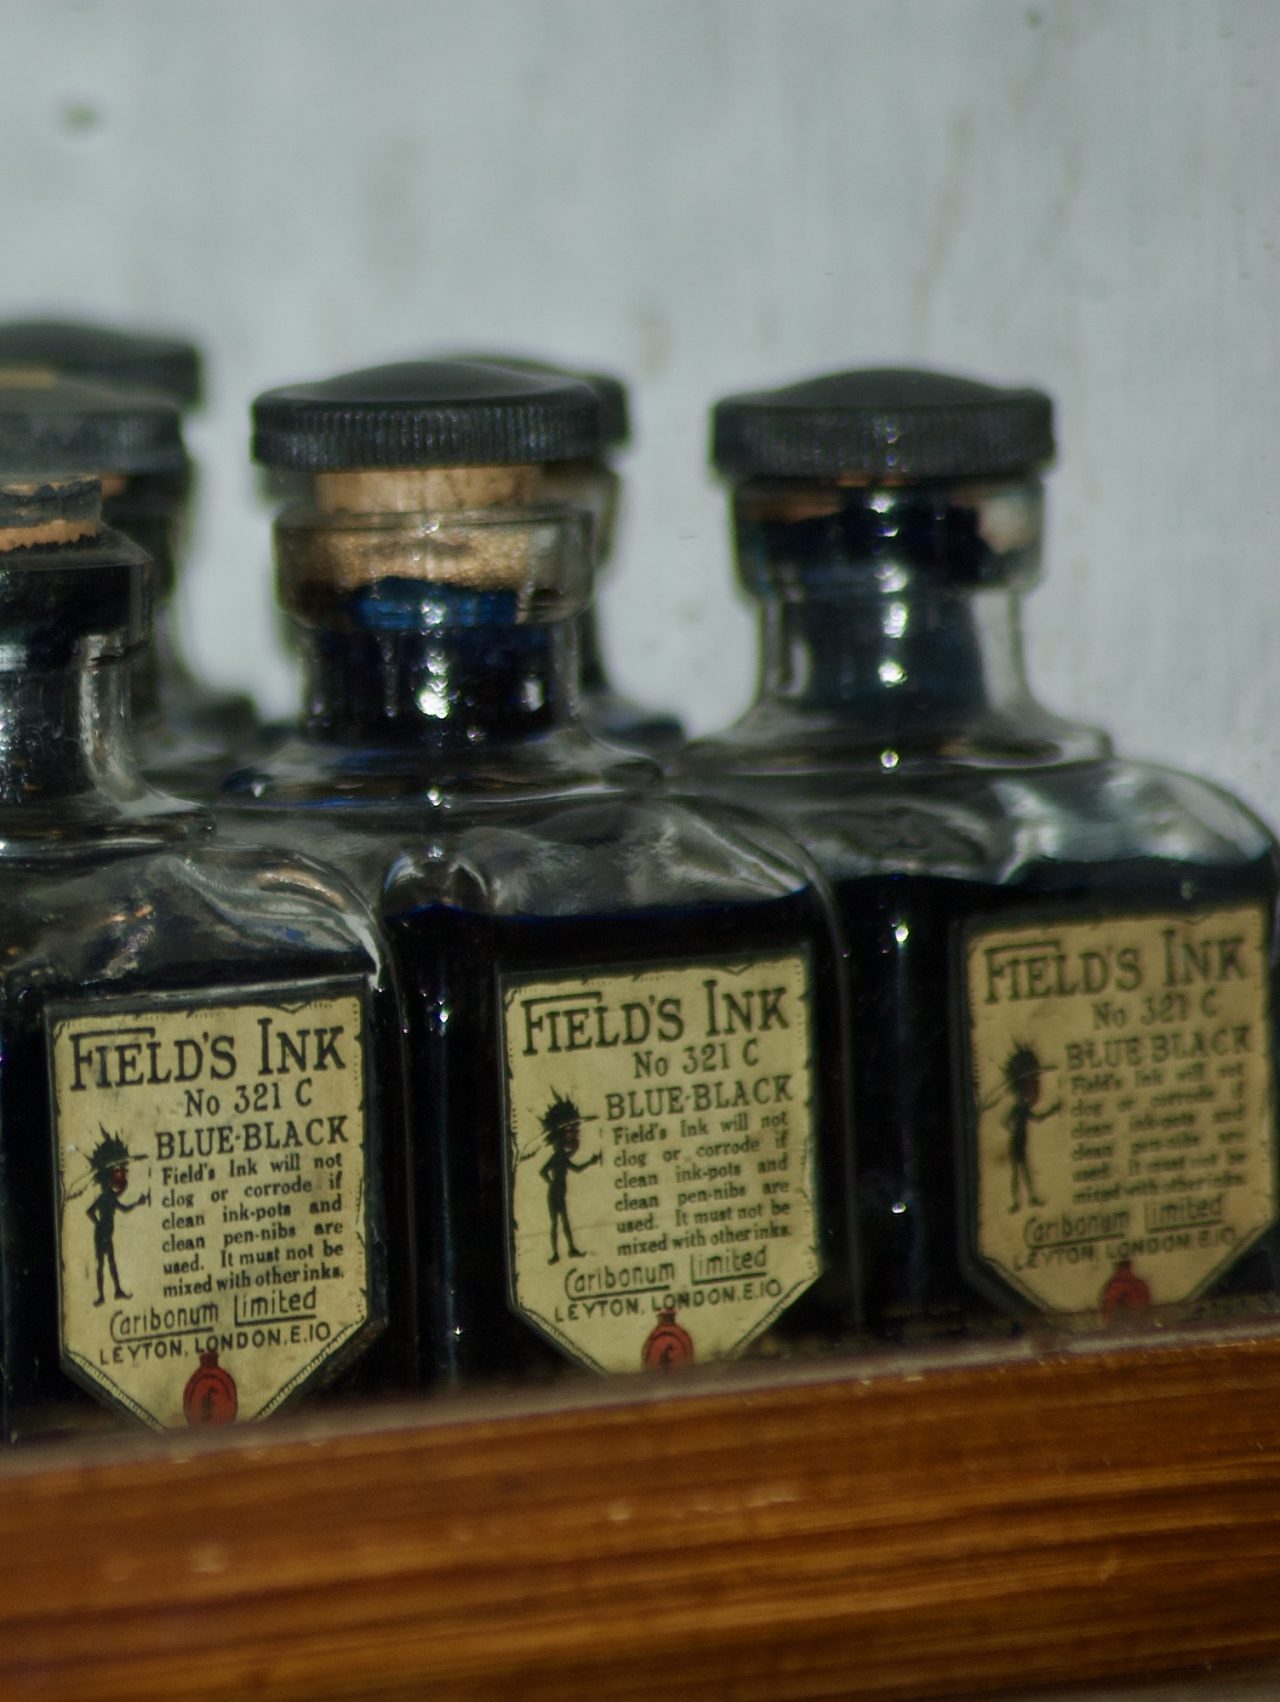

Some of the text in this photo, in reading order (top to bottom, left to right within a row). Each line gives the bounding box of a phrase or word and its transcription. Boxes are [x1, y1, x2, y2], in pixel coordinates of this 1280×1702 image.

[984, 927, 1247, 1005] FIELD'S INK
[521, 979, 789, 1056] FIELD'S INK
[1141, 992, 1190, 1025] 321
[1200, 988, 1218, 1018] C
[69, 1017, 346, 1092] FIELD'S INK
[633, 1038, 759, 1079] No 321 C
[184, 1077, 312, 1117] No 321 C
[612, 1112, 788, 1145] Field's Ink will not
[614, 1130, 788, 1168] clog or corrode if
[162, 1153, 342, 1186] Field's Ink will not
[615, 1152, 788, 1189] clean ink-pots and
[162, 1171, 342, 1208] clog or corrode if
[615, 1182, 789, 1211] clean pen-nibs are
[162, 1193, 341, 1230] clean ink-pots and
[617, 1199, 790, 1233] used. It must not be
[1147, 1193, 1225, 1234] Limited
[162, 1222, 343, 1252] clean pen-nibs are
[617, 1233, 668, 1256] mixed
[672, 1230, 706, 1248] with
[711, 1224, 755, 1245] other
[163, 1239, 343, 1275] used. It must not be
[564, 1245, 768, 1302] Caribonum Limited
[163, 1262, 343, 1297] mixed with other inks.
[110, 1286, 317, 1344] Caribonum Limited
